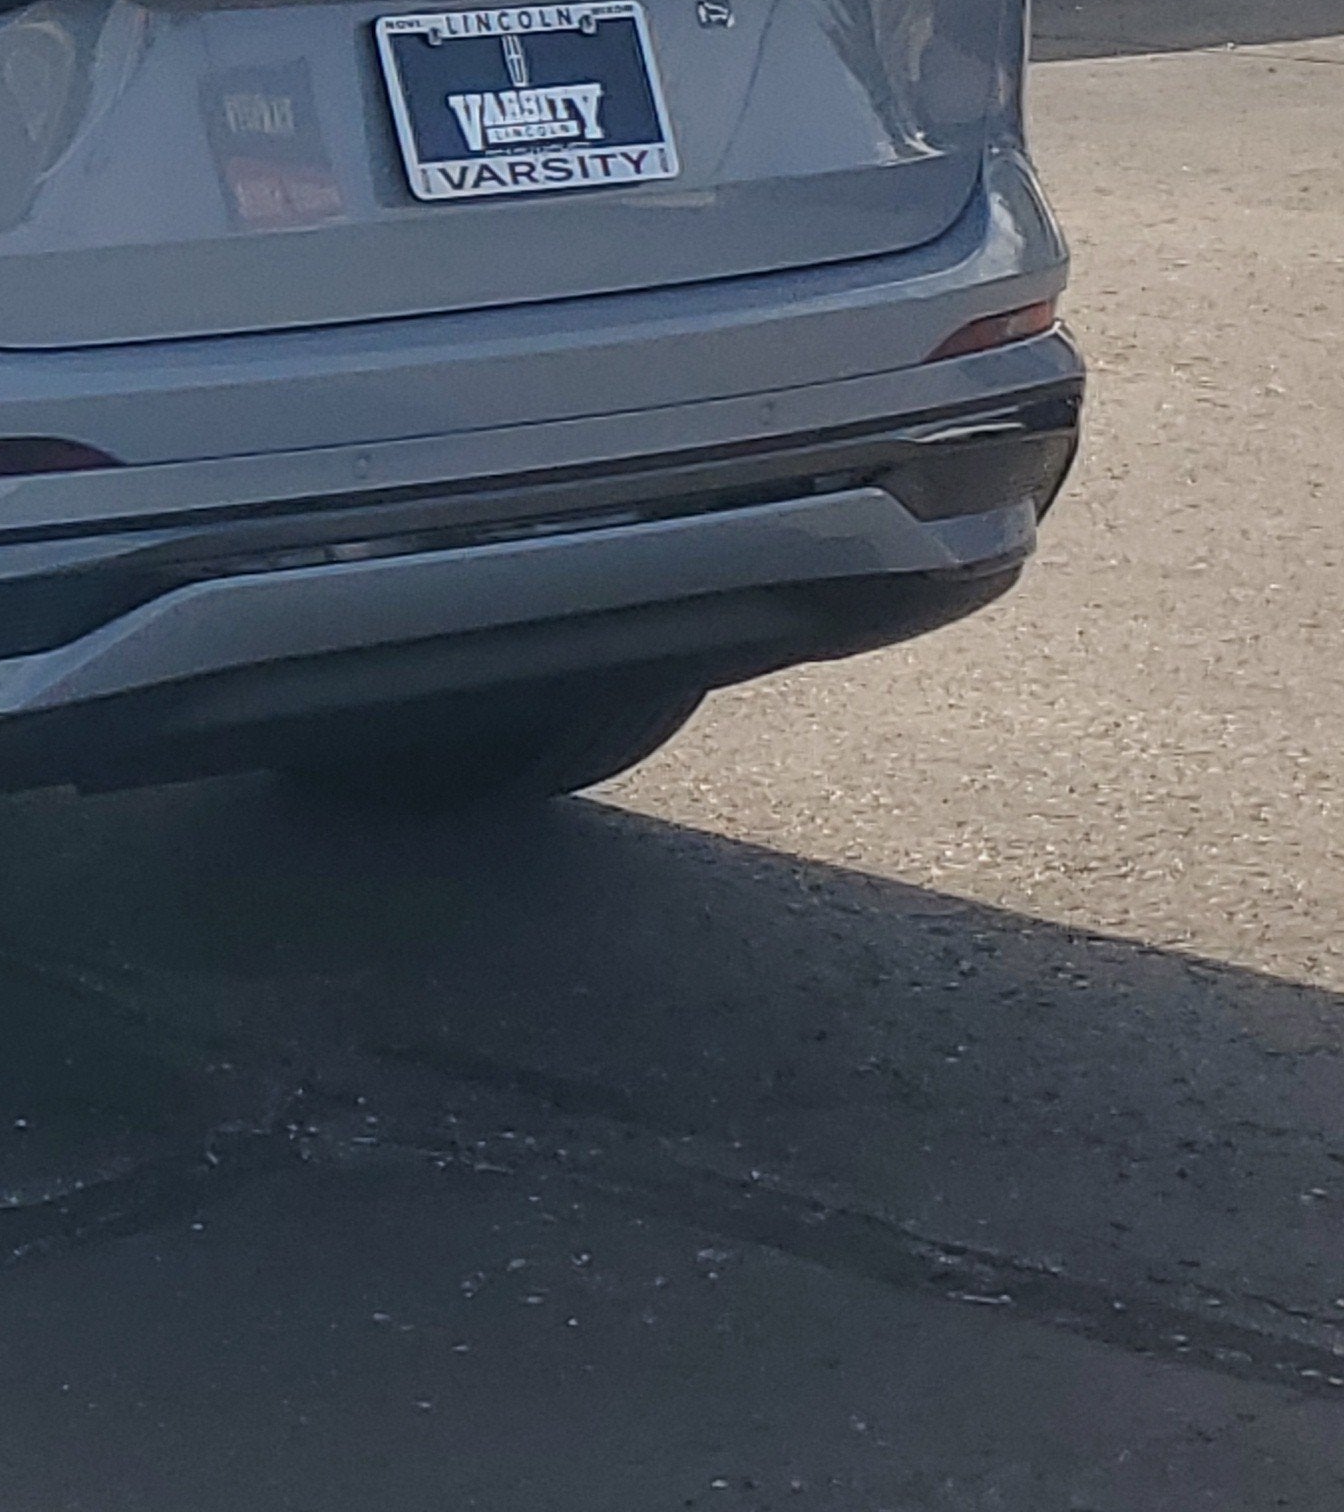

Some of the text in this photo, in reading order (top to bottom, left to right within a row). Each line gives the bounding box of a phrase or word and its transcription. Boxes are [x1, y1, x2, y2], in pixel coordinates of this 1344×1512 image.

[444, 7, 574, 35] LINCOLN
[448, 83, 605, 152] VARSITY
[438, 149, 650, 191] VARSITY
